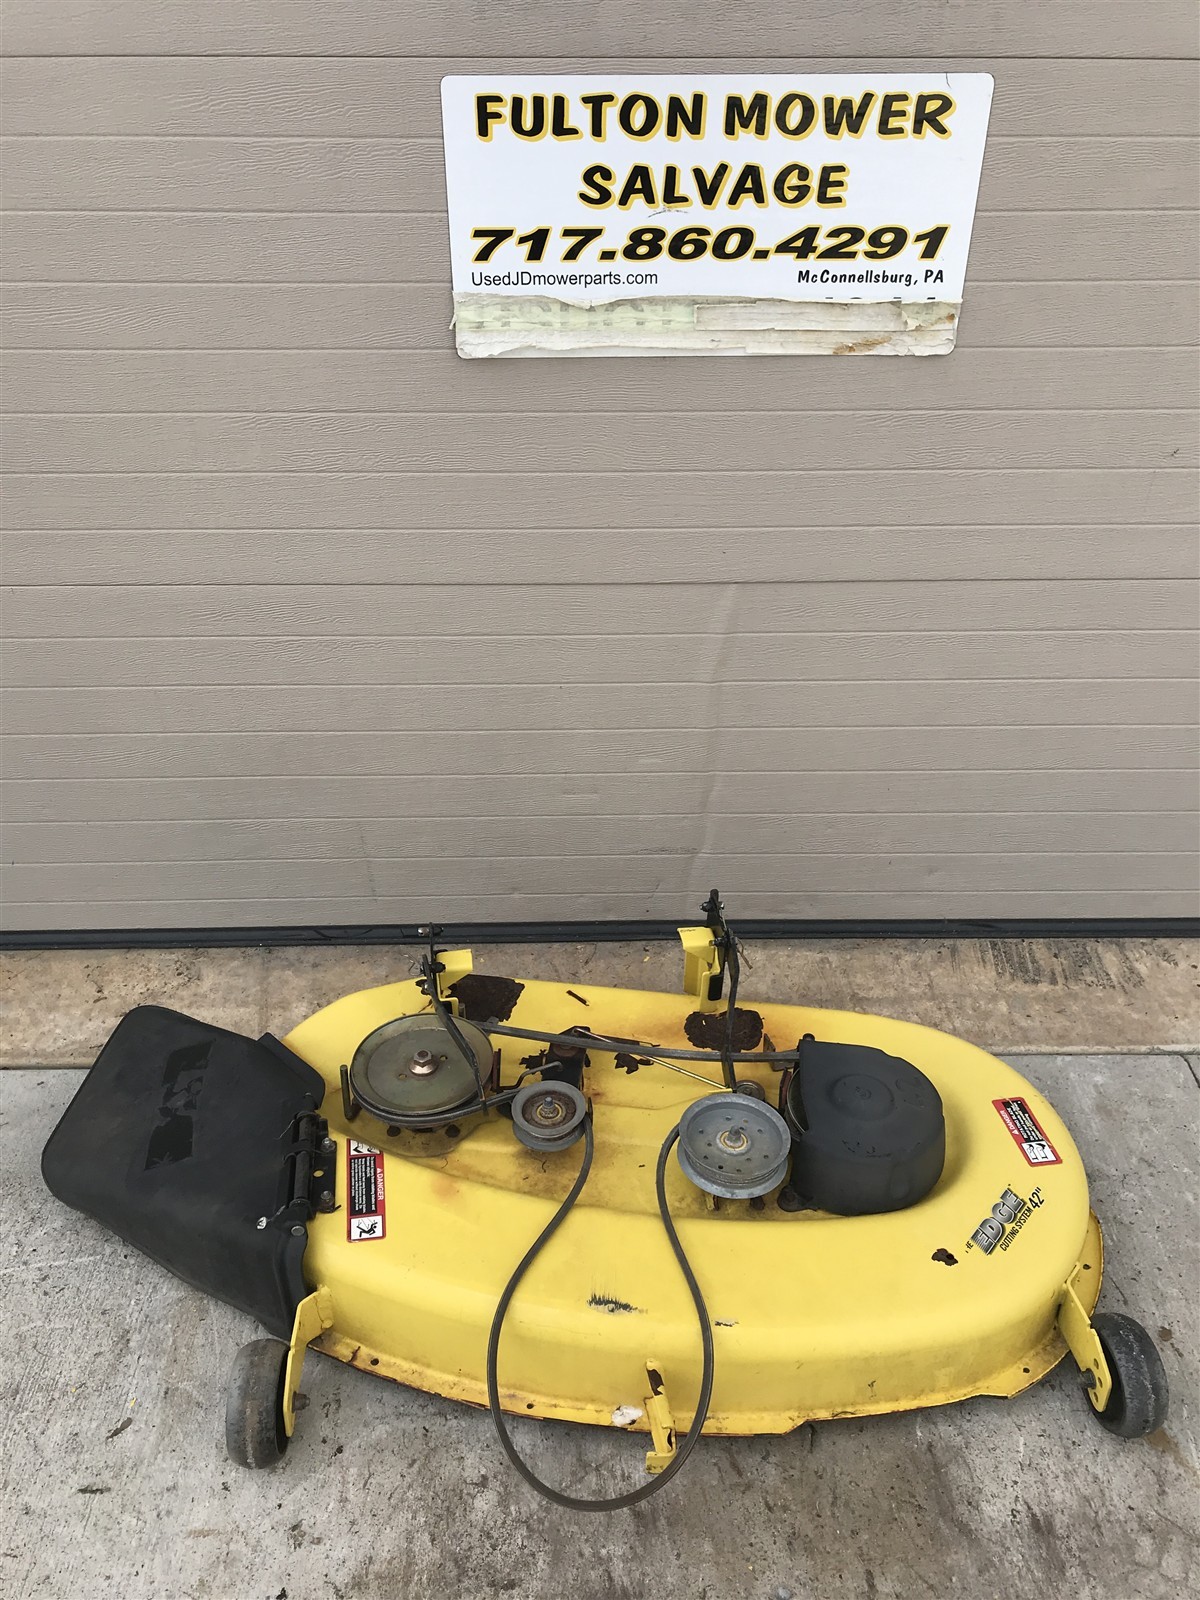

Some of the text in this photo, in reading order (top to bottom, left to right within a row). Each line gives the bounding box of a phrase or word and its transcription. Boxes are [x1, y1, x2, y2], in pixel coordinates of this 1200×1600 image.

[474, 91, 956, 142] FULTON MOWER
[578, 162, 849, 209] SALVAGE
[470, 224, 950, 263] 717.860.4291
[471, 271, 658, 288] UsedJDmowerparts.com
[797, 269, 945, 287] McConnellsburg, PA
[970, 1188, 1027, 1256] EDGE
[999, 1226, 1020, 1252] CUTTING
[1014, 1205, 1034, 1230] SYSTEM
